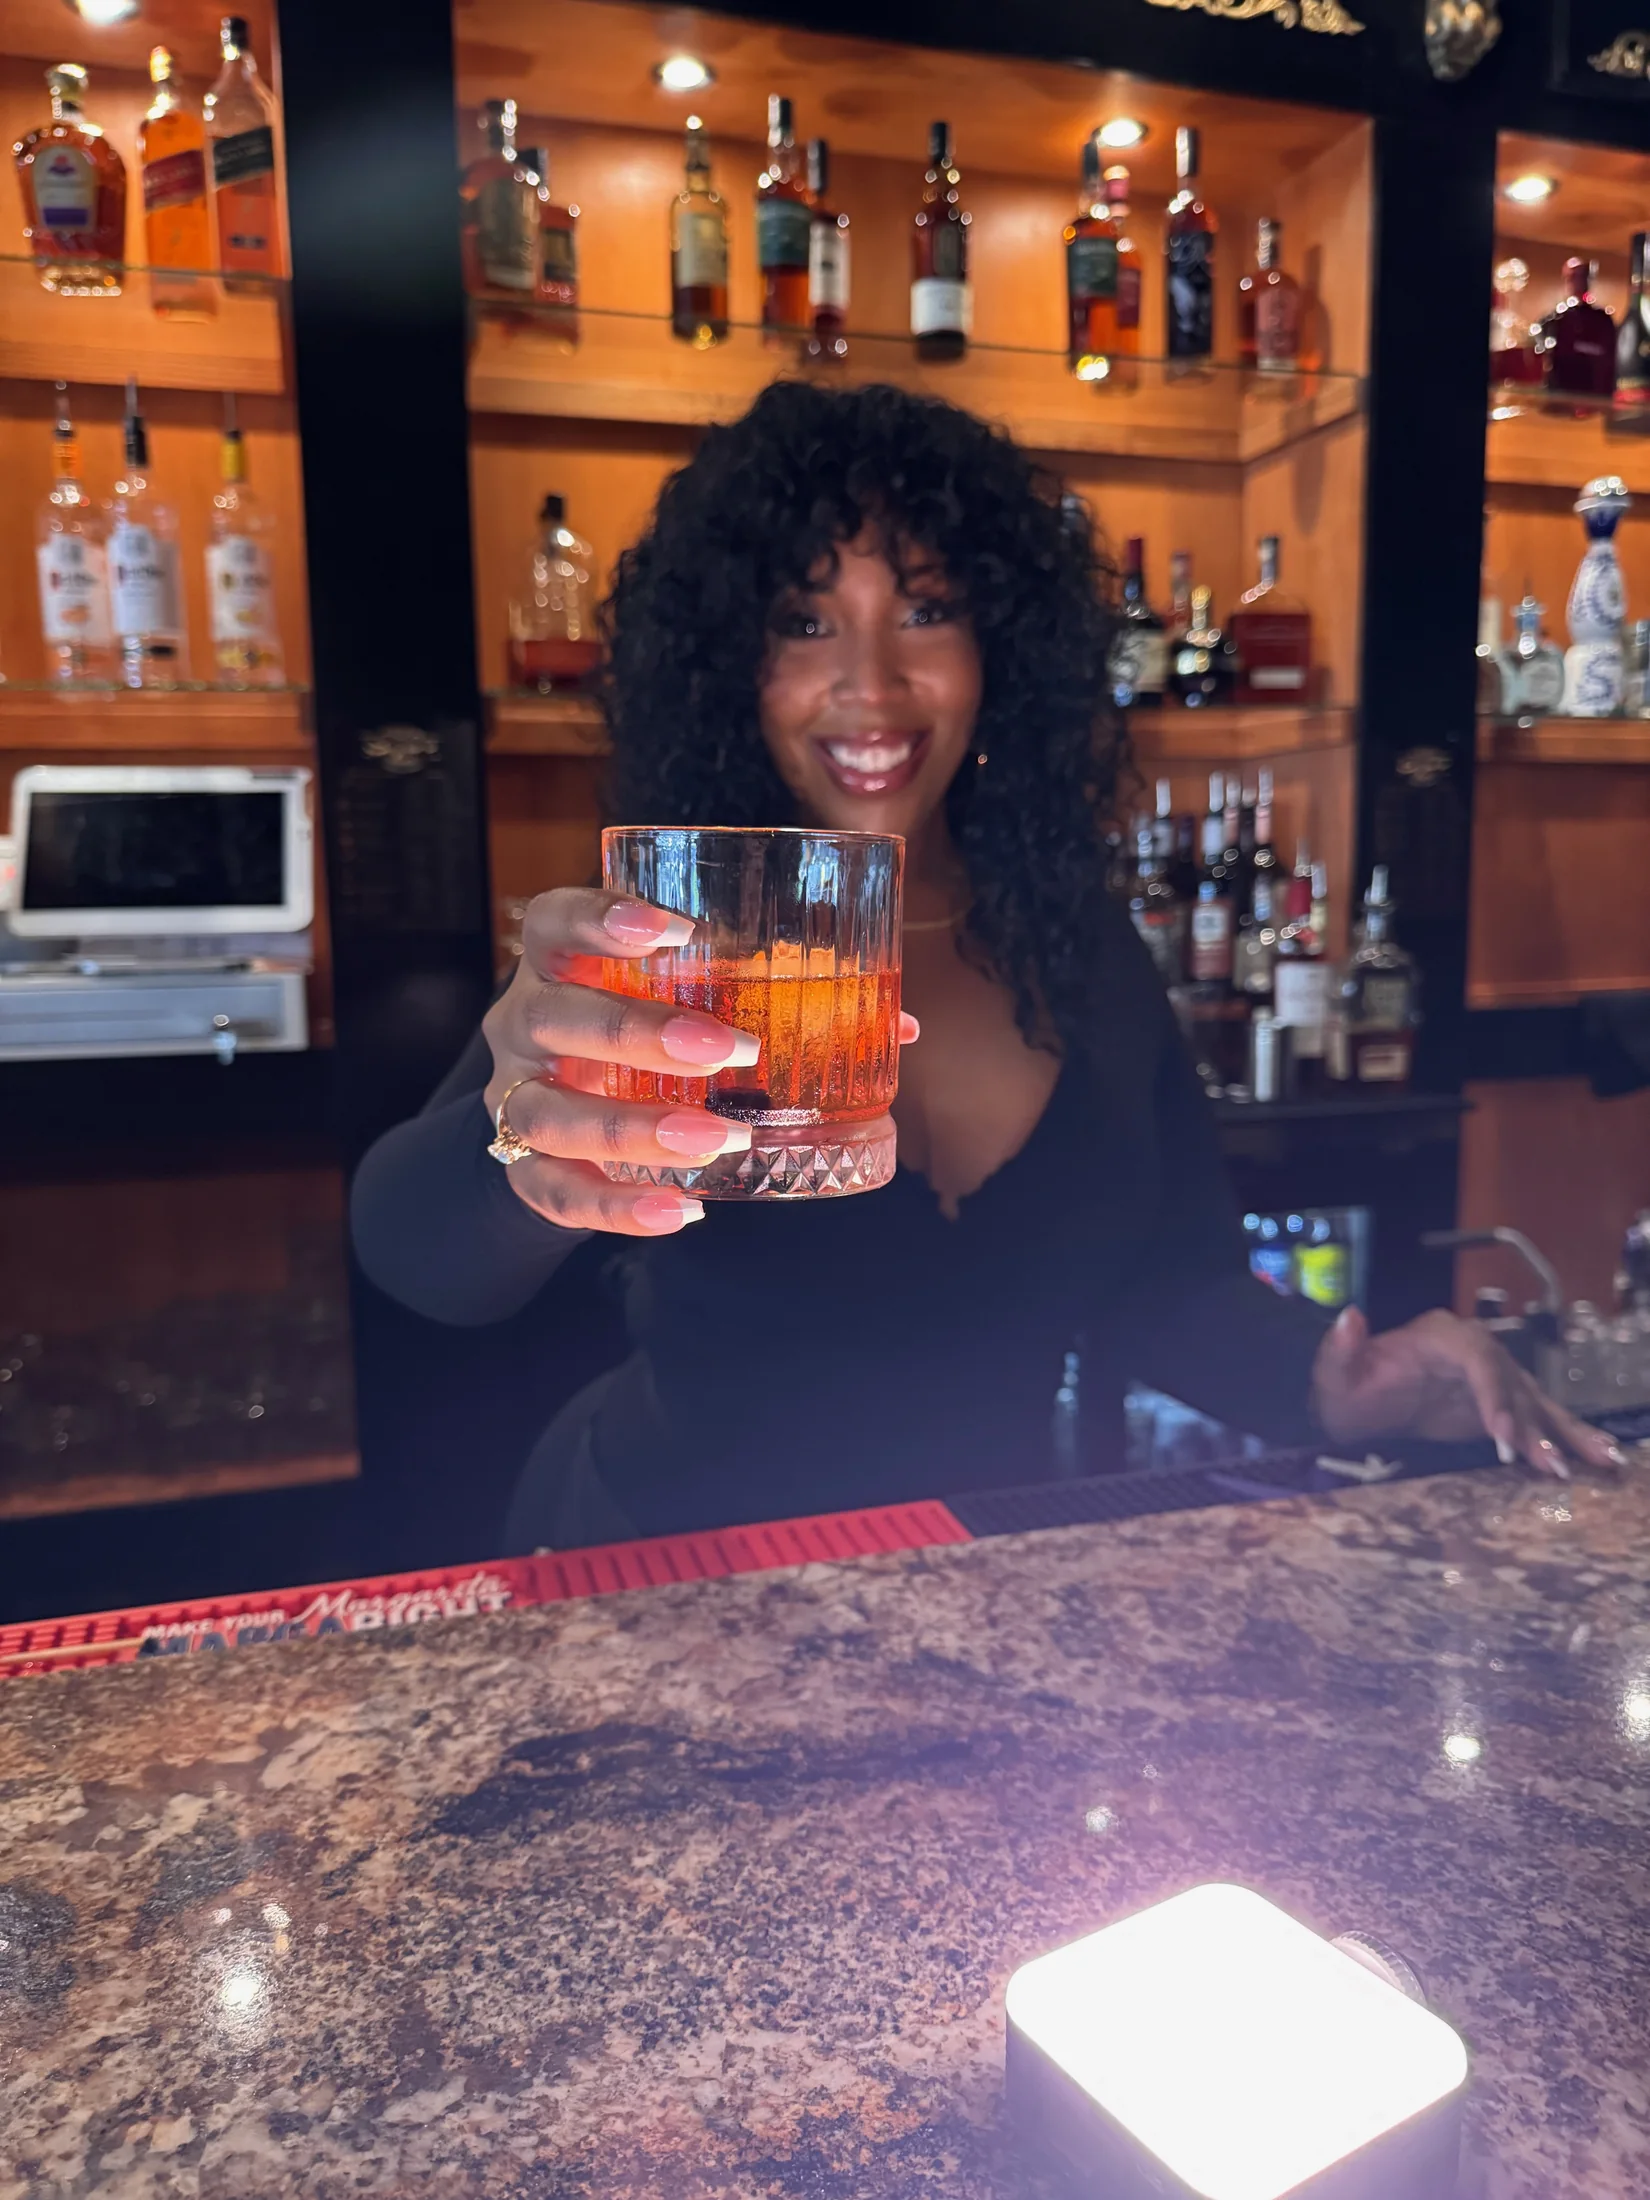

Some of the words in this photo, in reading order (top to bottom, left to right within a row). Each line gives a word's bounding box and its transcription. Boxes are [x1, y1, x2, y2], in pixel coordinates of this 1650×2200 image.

[142, 1617, 214, 1640] MAKE
[223, 1608, 285, 1630] YOUR
[291, 1570, 508, 1623] Margarita
